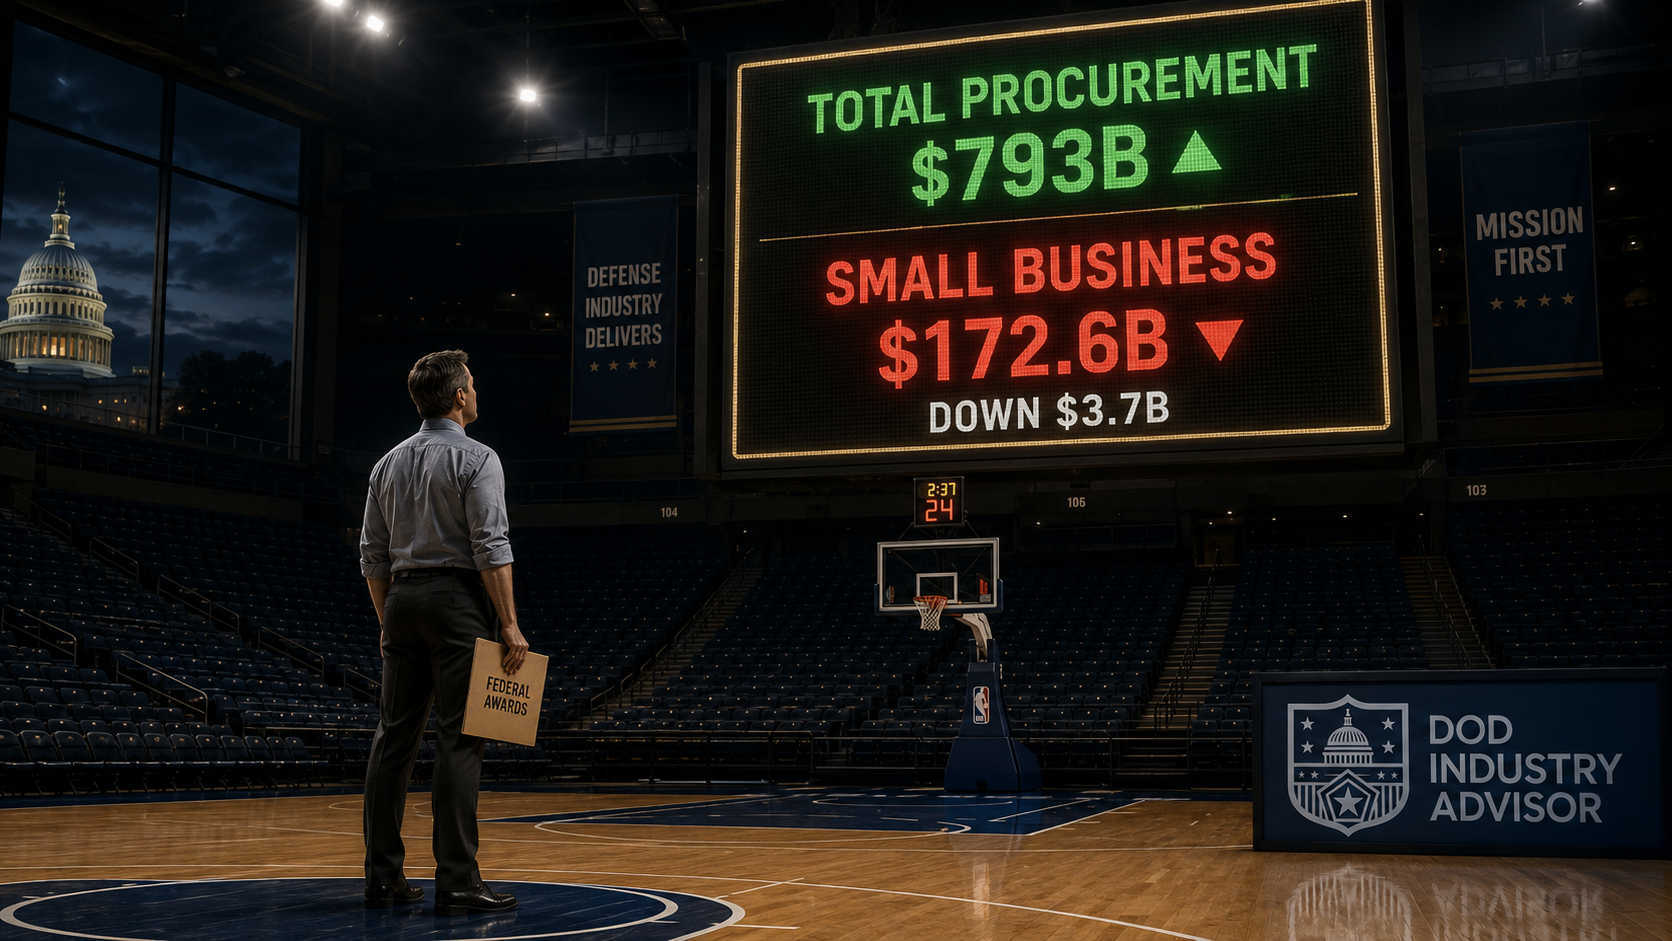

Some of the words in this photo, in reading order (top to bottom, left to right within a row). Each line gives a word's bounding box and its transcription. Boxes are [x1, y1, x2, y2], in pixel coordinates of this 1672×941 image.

[807, 82, 946, 134] TOTAL
[961, 44, 1317, 119] PROCUREMENT
[911, 124, 1149, 207] $793B
[1475, 206, 1584, 241] MISSION
[587, 262, 661, 288] DEFENSE
[825, 251, 994, 306] SMALL
[1014, 231, 1277, 294] BUSINESS
[1494, 243, 1567, 276] FIRST
[585, 293, 663, 318] INDUSTRY
[585, 323, 662, 349] DELIVERS
[878, 309, 1169, 389] $172.6B
[929, 397, 1040, 434] DOWN
[1056, 390, 1170, 430] $3.7B
[927, 482, 956, 497] 2:37
[1466, 484, 1487, 496] 103
[660, 507, 678, 518] 104
[925, 498, 953, 522] 24
[486, 675, 530, 699] FEDERAL
[483, 694, 528, 716] AWARDS
[1429, 714, 1513, 745] DOD
[1430, 752, 1623, 785] INDUSTRY
[1430, 791, 1603, 823] ADVISOR
